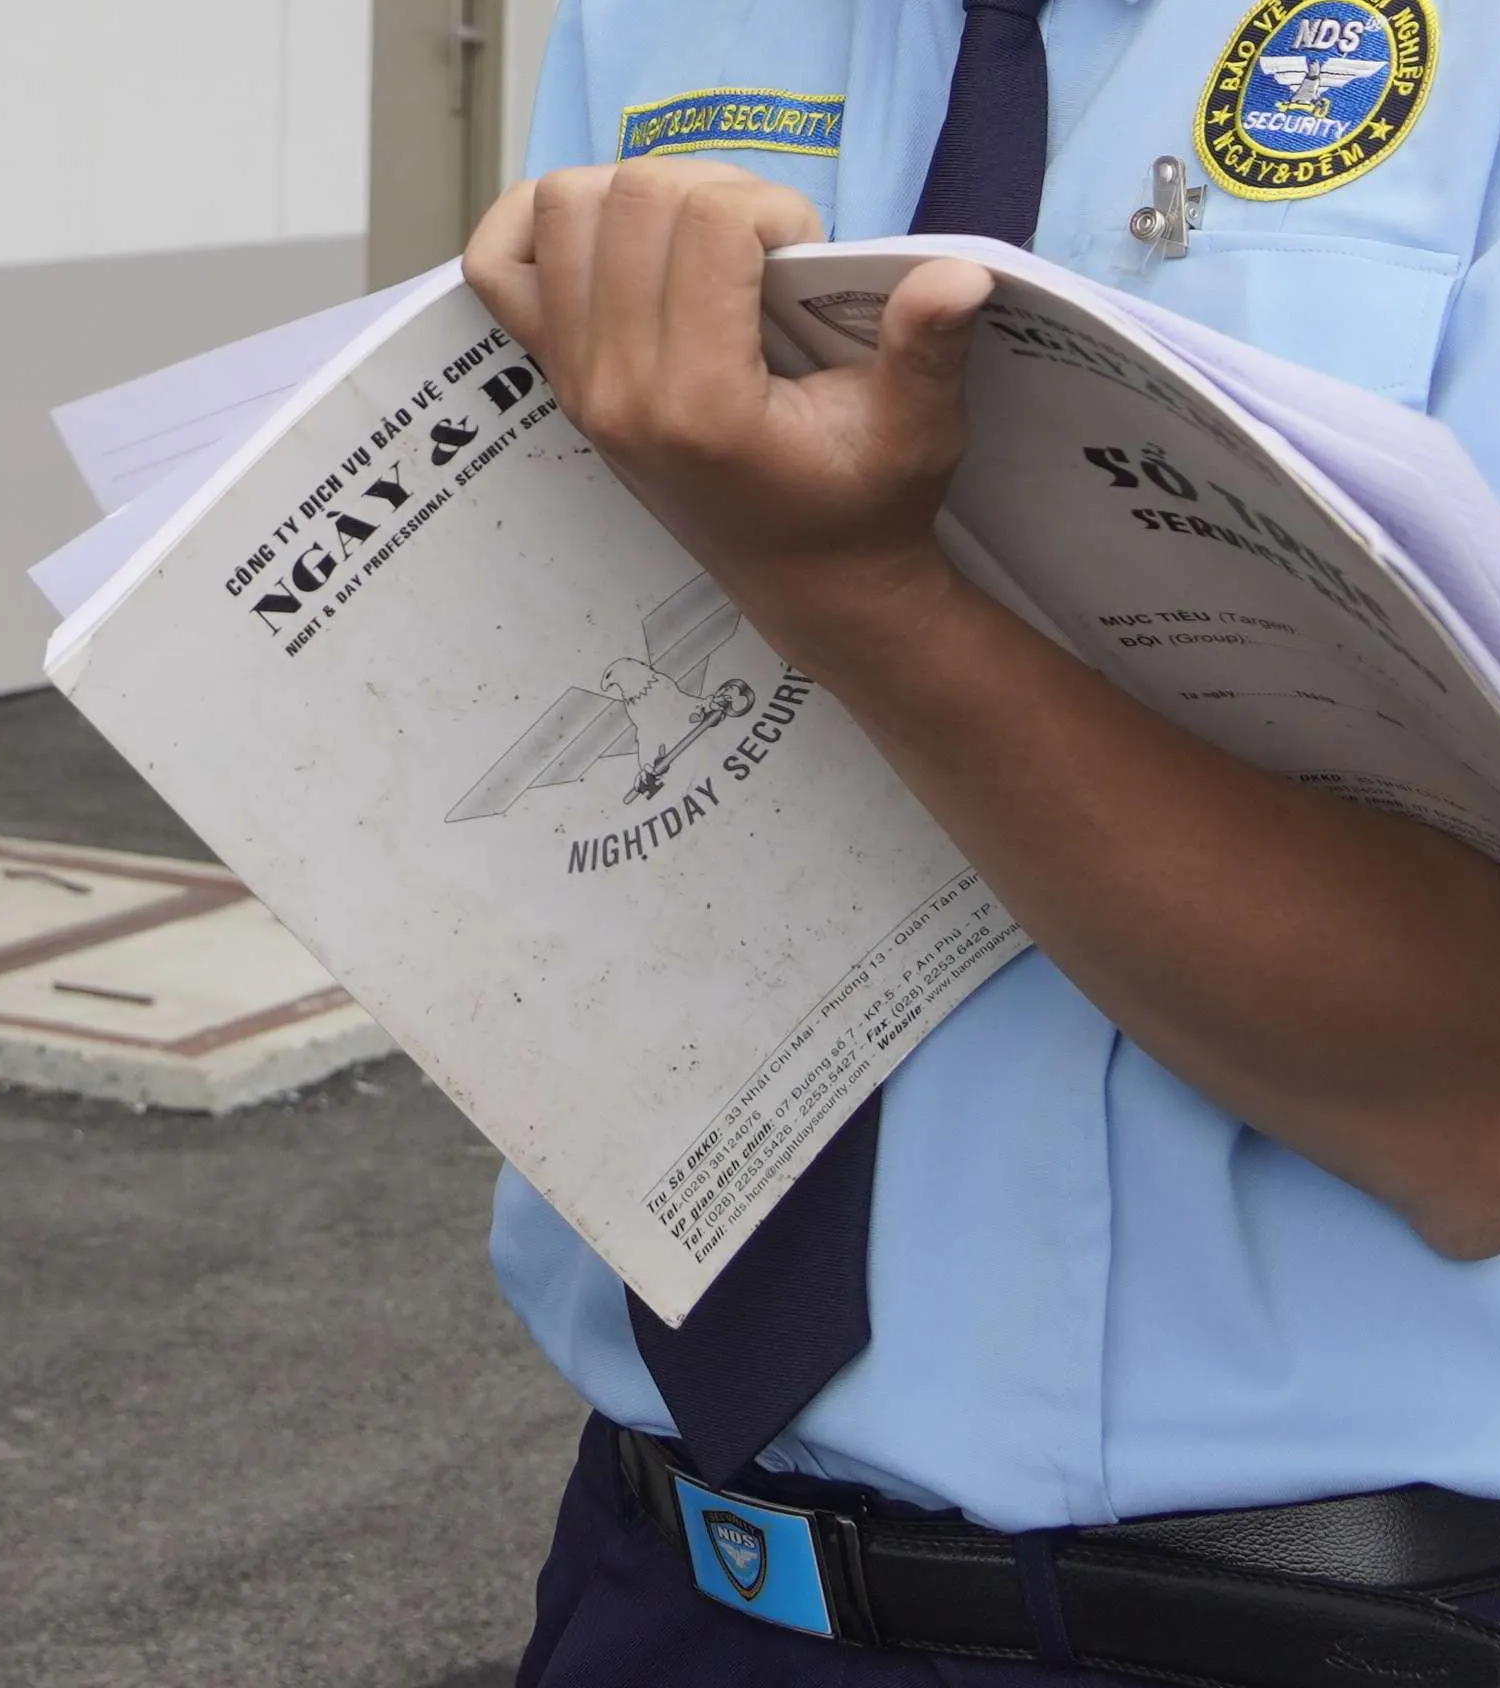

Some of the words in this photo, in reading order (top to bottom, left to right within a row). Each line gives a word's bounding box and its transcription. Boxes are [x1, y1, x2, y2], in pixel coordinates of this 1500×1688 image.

[1292, 18, 1364, 53] NDS
[718, 103, 841, 137] SECURITY
[1242, 111, 1351, 139] SECURITY
[223, 541, 276, 597] CÔNG
[272, 516, 299, 544] TY
[298, 473, 344, 519] DỊCH
[370, 407, 414, 449] BẢO
[442, 328, 511, 384] CHUYÊ
[1082, 441, 1198, 502] SỔ
[249, 459, 413, 636] NGÀY
[430, 414, 478, 466] &
[285, 615, 322, 657] NIGHT
[321, 603, 336, 618] &
[335, 574, 363, 604] DAY
[362, 488, 454, 576] PROFESSIONAL
[454, 426, 518, 486] SECURITY
[520, 397, 557, 429] SERV
[1130, 508, 1306, 582] SERVICE
[569, 777, 719, 873] NIGHTDAY
[724, 675, 813, 779] SECURI
[724, 1105, 742, 1126] 33
[869, 951, 887, 968] 13
[705, 1190, 735, 1227] (028)
[890, 984, 923, 1017] (028)
[670, 1217, 688, 1237] VP
[690, 1188, 715, 1220] giao
[774, 1098, 790, 1118] 07
[680, 1168, 710, 1202] (028)
[717, 1525, 755, 1549] NDS
